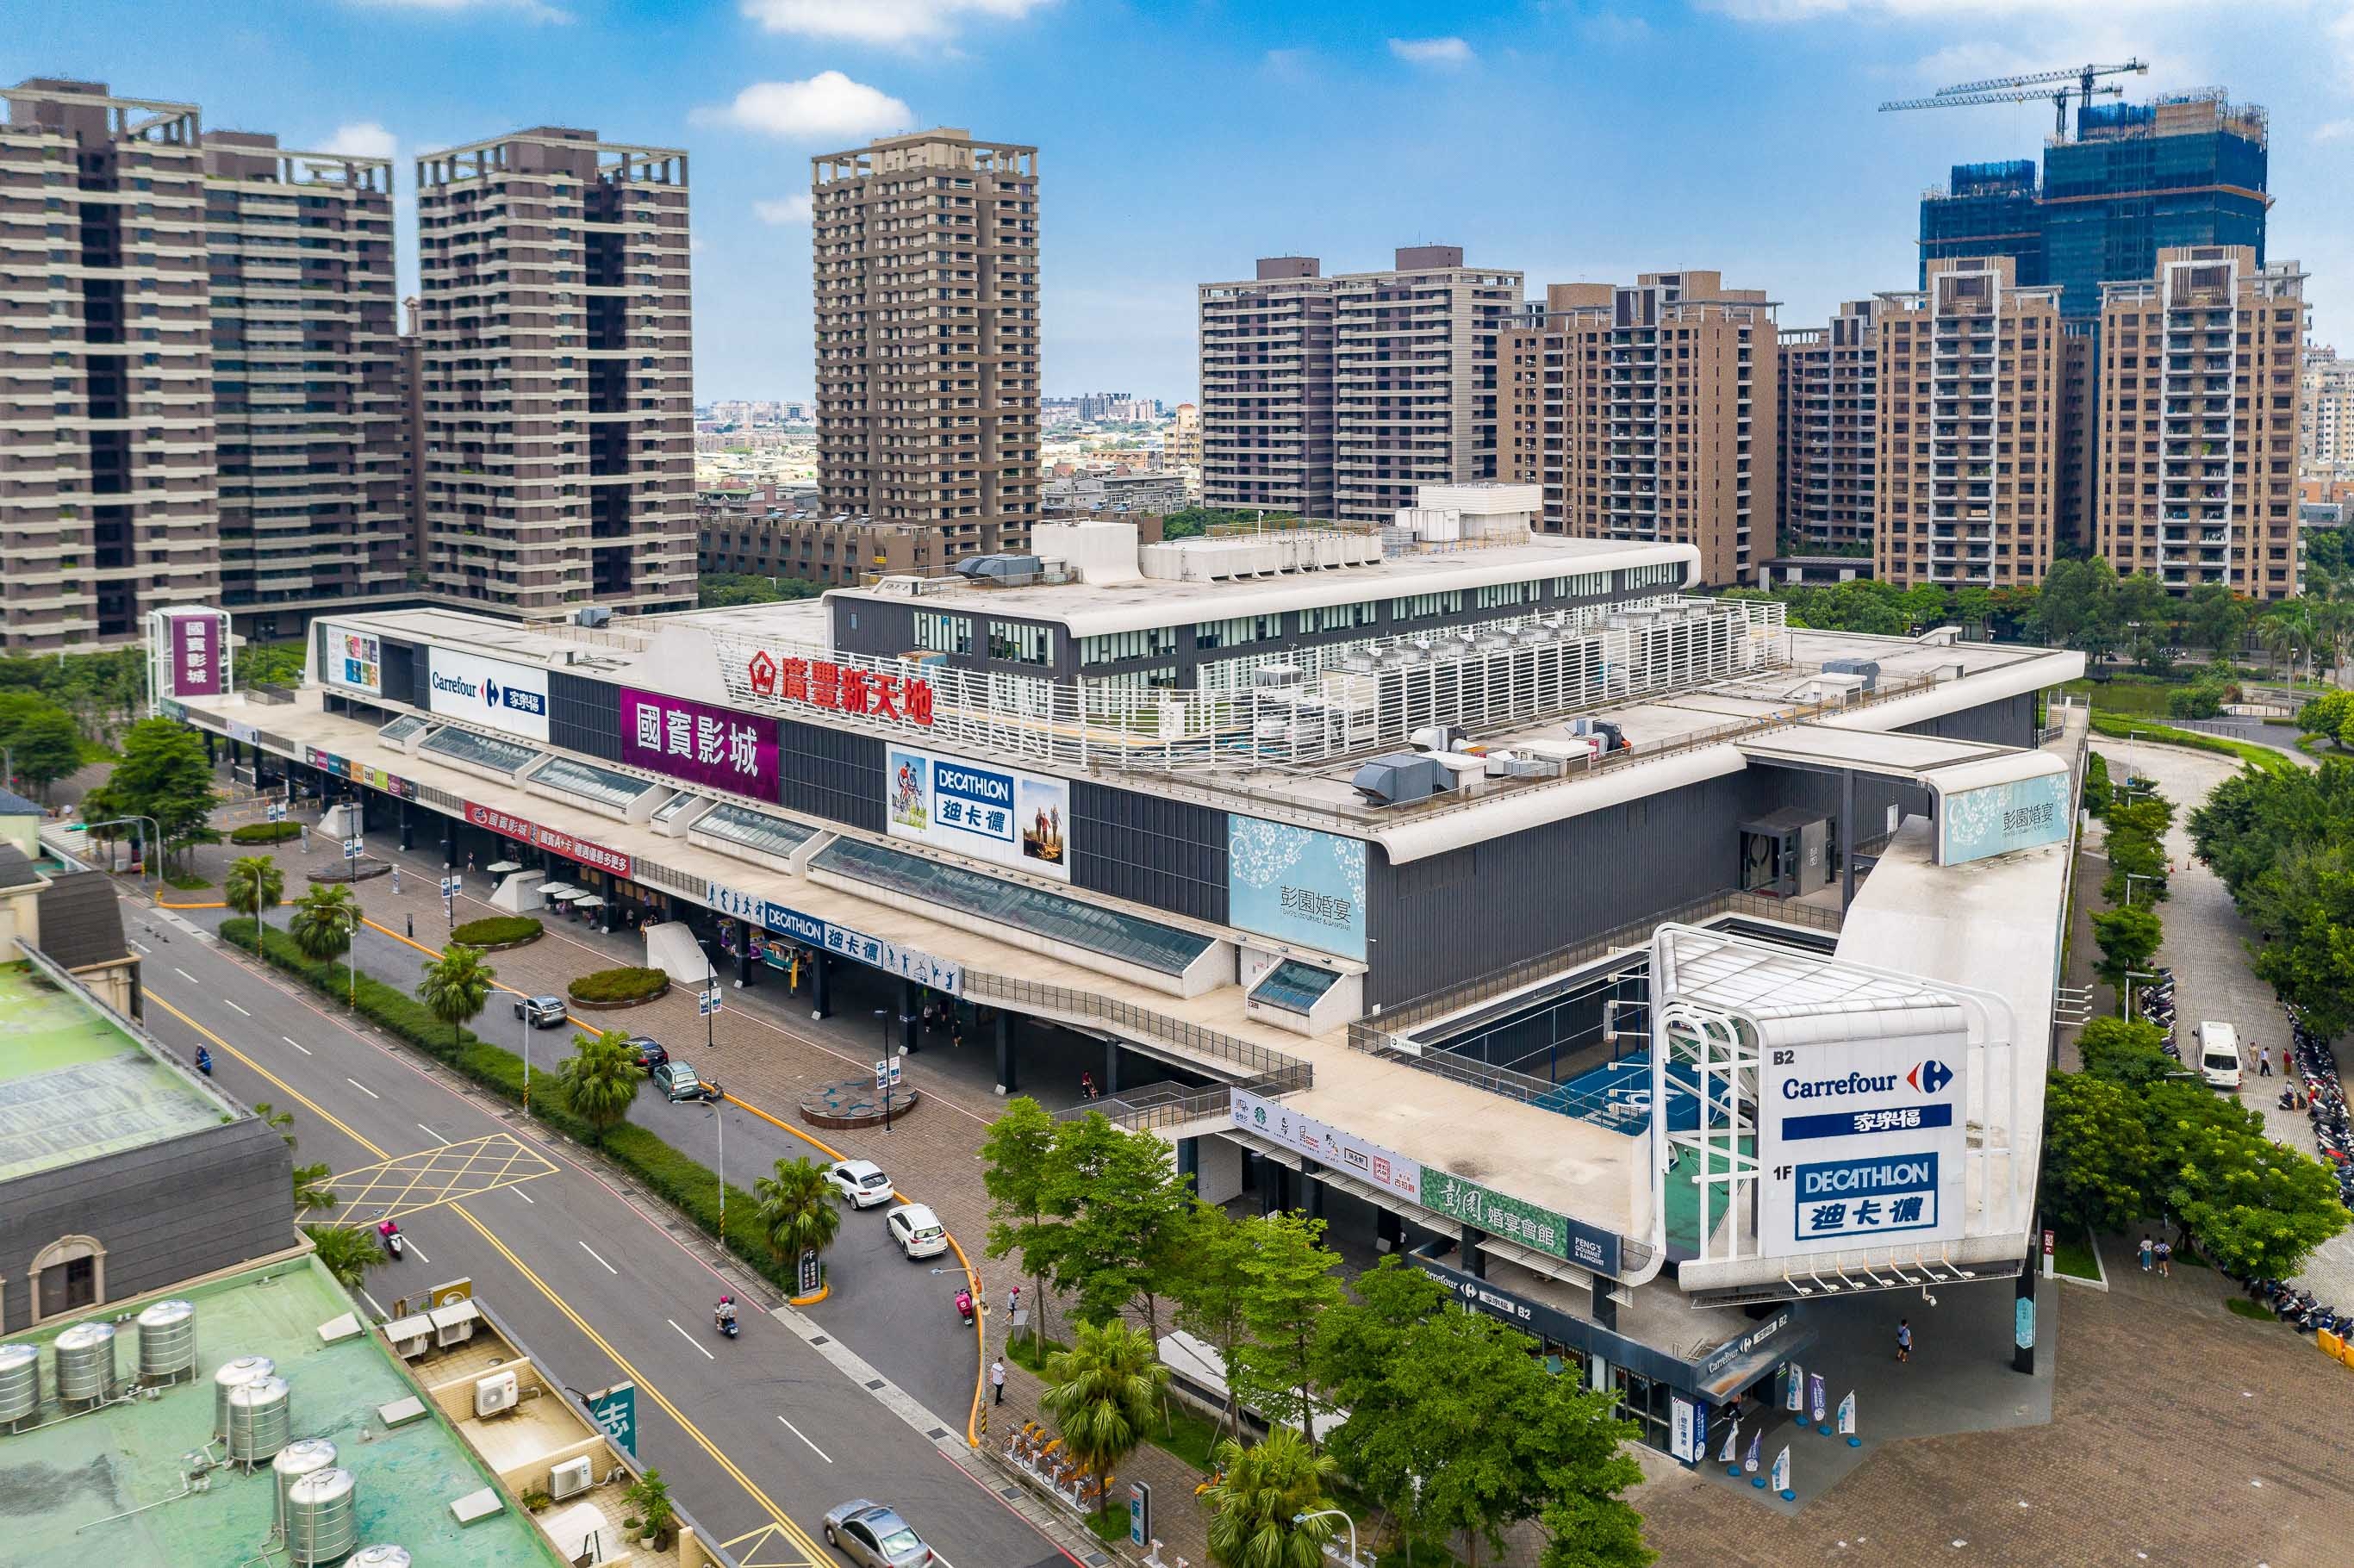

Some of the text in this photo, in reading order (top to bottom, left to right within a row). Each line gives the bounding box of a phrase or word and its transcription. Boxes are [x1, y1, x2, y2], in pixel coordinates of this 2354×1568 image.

[185, 621, 208, 684] 國賓影城
[432, 670, 477, 698] Carrefour
[782, 657, 933, 725] 廣豐新天地
[508, 690, 539, 713] 家樂福
[636, 702, 759, 778] 國賓影城
[938, 768, 1009, 802] DECATHLON
[489, 812, 527, 837] 國賓影城
[942, 800, 1006, 833] 迪卡儂
[2002, 802, 2055, 831] 彭園婚宴
[1280, 884, 1351, 924] 彭園婚宴
[769, 908, 821, 942] DECATHLON
[828, 929, 878, 962] 迪卡儂
[1773, 1050, 1795, 1065] B2
[1782, 1072, 1897, 1099] Carrefour
[1853, 1109, 1921, 1131] 家樂福
[1773, 1166, 1792, 1180] 1F
[1805, 1162, 1928, 1193] DECATHLON
[1441, 1179, 1554, 1248] 彭園 婚宴會館
[1811, 1197, 1923, 1230] 迪卡儂
[1575, 1237, 1602, 1254] PENG'S
[1575, 1245, 1601, 1259] GOURMET
[1579, 1253, 1604, 1266] BANQUET
[1517, 1305, 1531, 1321] B2
[1778, 1314, 1788, 1328] B2
[1708, 1348, 1739, 1373] Carrefour
[597, 1402, 631, 1449] 志
